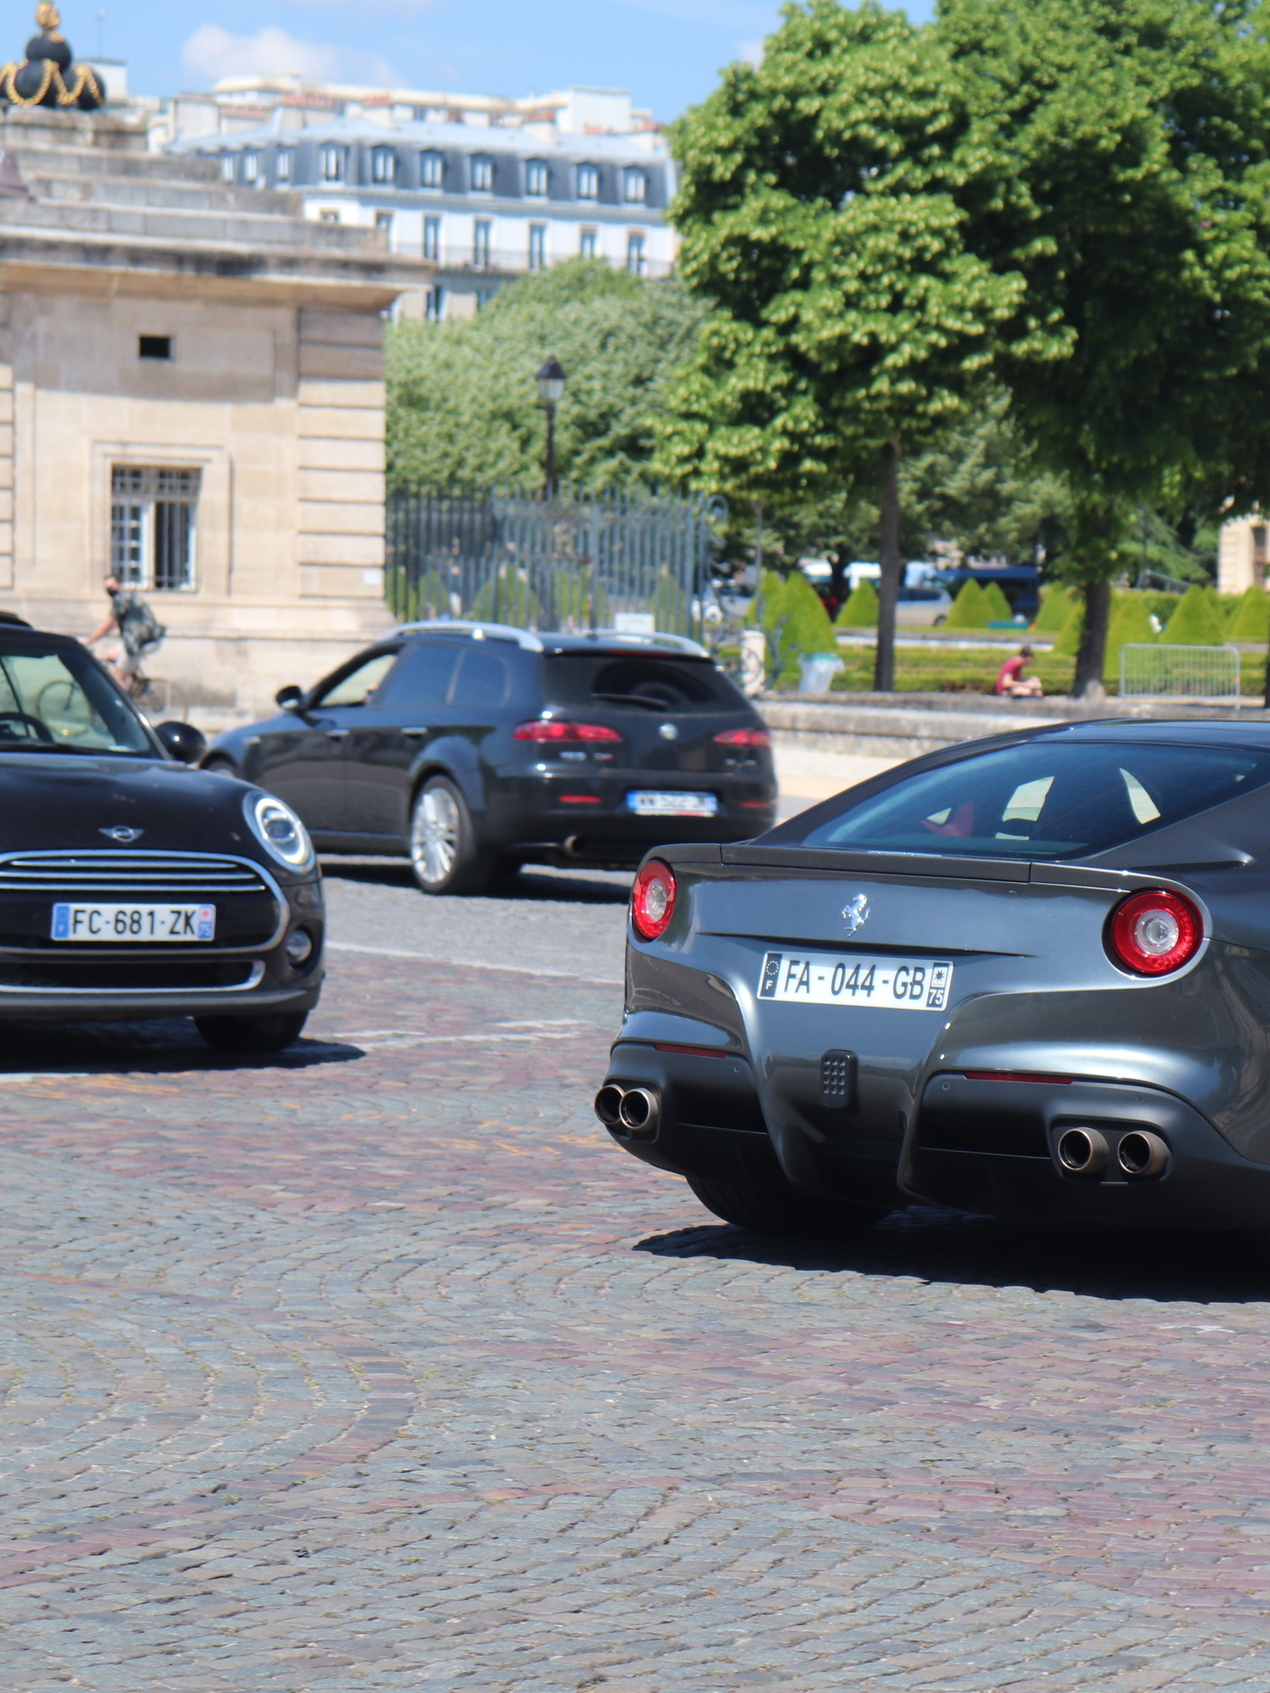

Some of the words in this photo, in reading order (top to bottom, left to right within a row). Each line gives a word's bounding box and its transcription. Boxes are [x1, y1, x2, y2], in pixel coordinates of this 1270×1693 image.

[72, 908, 196, 935] FC-681-ZK
[765, 980, 774, 990] F
[928, 989, 943, 1005] 75
